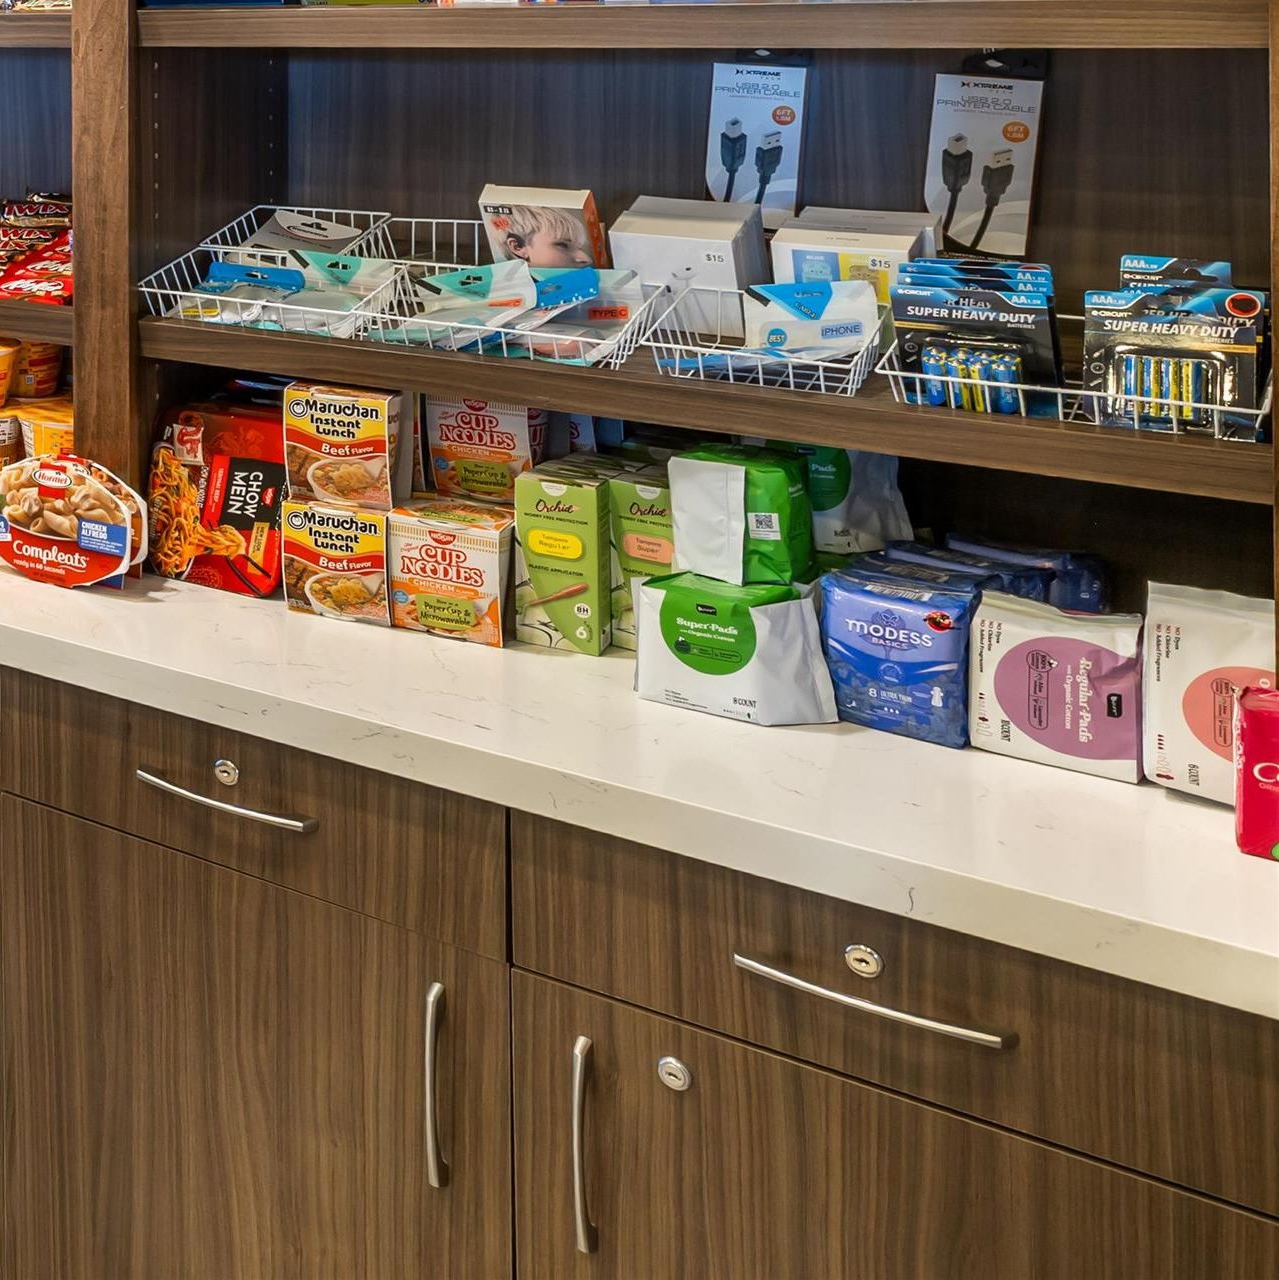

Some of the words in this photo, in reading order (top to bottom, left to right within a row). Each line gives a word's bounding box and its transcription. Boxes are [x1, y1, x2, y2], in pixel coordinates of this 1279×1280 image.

[715, 87, 759, 95] PRINTER
[761, 90, 800, 98] CABLE
[937, 100, 988, 109] PRINTER
[4, 203, 69, 218] TWIX
[706, 253, 724, 262] $15
[870, 258, 890, 268] $15
[1125, 259, 1145, 269] AAA
[592, 310, 615, 319] TYPE
[618, 308, 627, 318] C
[907, 306, 949, 317] SUPER
[952, 309, 996, 320] HEAVY
[999, 313, 1035, 323] DUTY
[821, 325, 861, 337] IPHONE
[1103, 320, 1147, 332] SUPER
[1150, 323, 1197, 335] HEAVY
[1200, 326, 1239, 338] DUTY
[769, 334, 785, 342] BEST
[305, 399, 380, 421] Maruchan
[310, 416, 361, 428] Instant
[456, 412, 497, 429] CUP
[316, 426, 355, 438] Lunch
[440, 424, 515, 450] NOODLES
[321, 444, 350, 456] Beef
[352, 446, 374, 454] Flavor
[451, 446, 490, 456] CHICKEN
[36, 472, 68, 486] Hormel
[228, 472, 241, 514] MEIN
[244, 472, 263, 518] CHOW
[536, 499, 574, 514] Orchid
[630, 501, 667, 518] Orchid
[81, 522, 106, 531] CHICKEN
[303, 511, 378, 535] Maruchan
[81, 529, 107, 539] ALFREDO
[308, 527, 359, 543] Instant
[314, 540, 354, 553] Lunch
[538, 541, 571, 551] Regular
[13, 540, 86, 569] Compleats
[421, 549, 467, 566] CUP
[319, 558, 347, 570] Beef
[349, 560, 372, 570] Flavor
[528, 563, 549, 572] PLASTIC
[550, 567, 583, 577] APPLICATOR
[401, 558, 483, 586] NOODLES
[413, 579, 454, 592] CHICKEN
[576, 606, 589, 614] 8H
[676, 616, 708, 628] Super
[711, 623, 738, 635] Pads
[872, 637, 908, 649] BASICS
[1079, 656, 1093, 706] Regular
[1079, 712, 1089, 744] Pads
